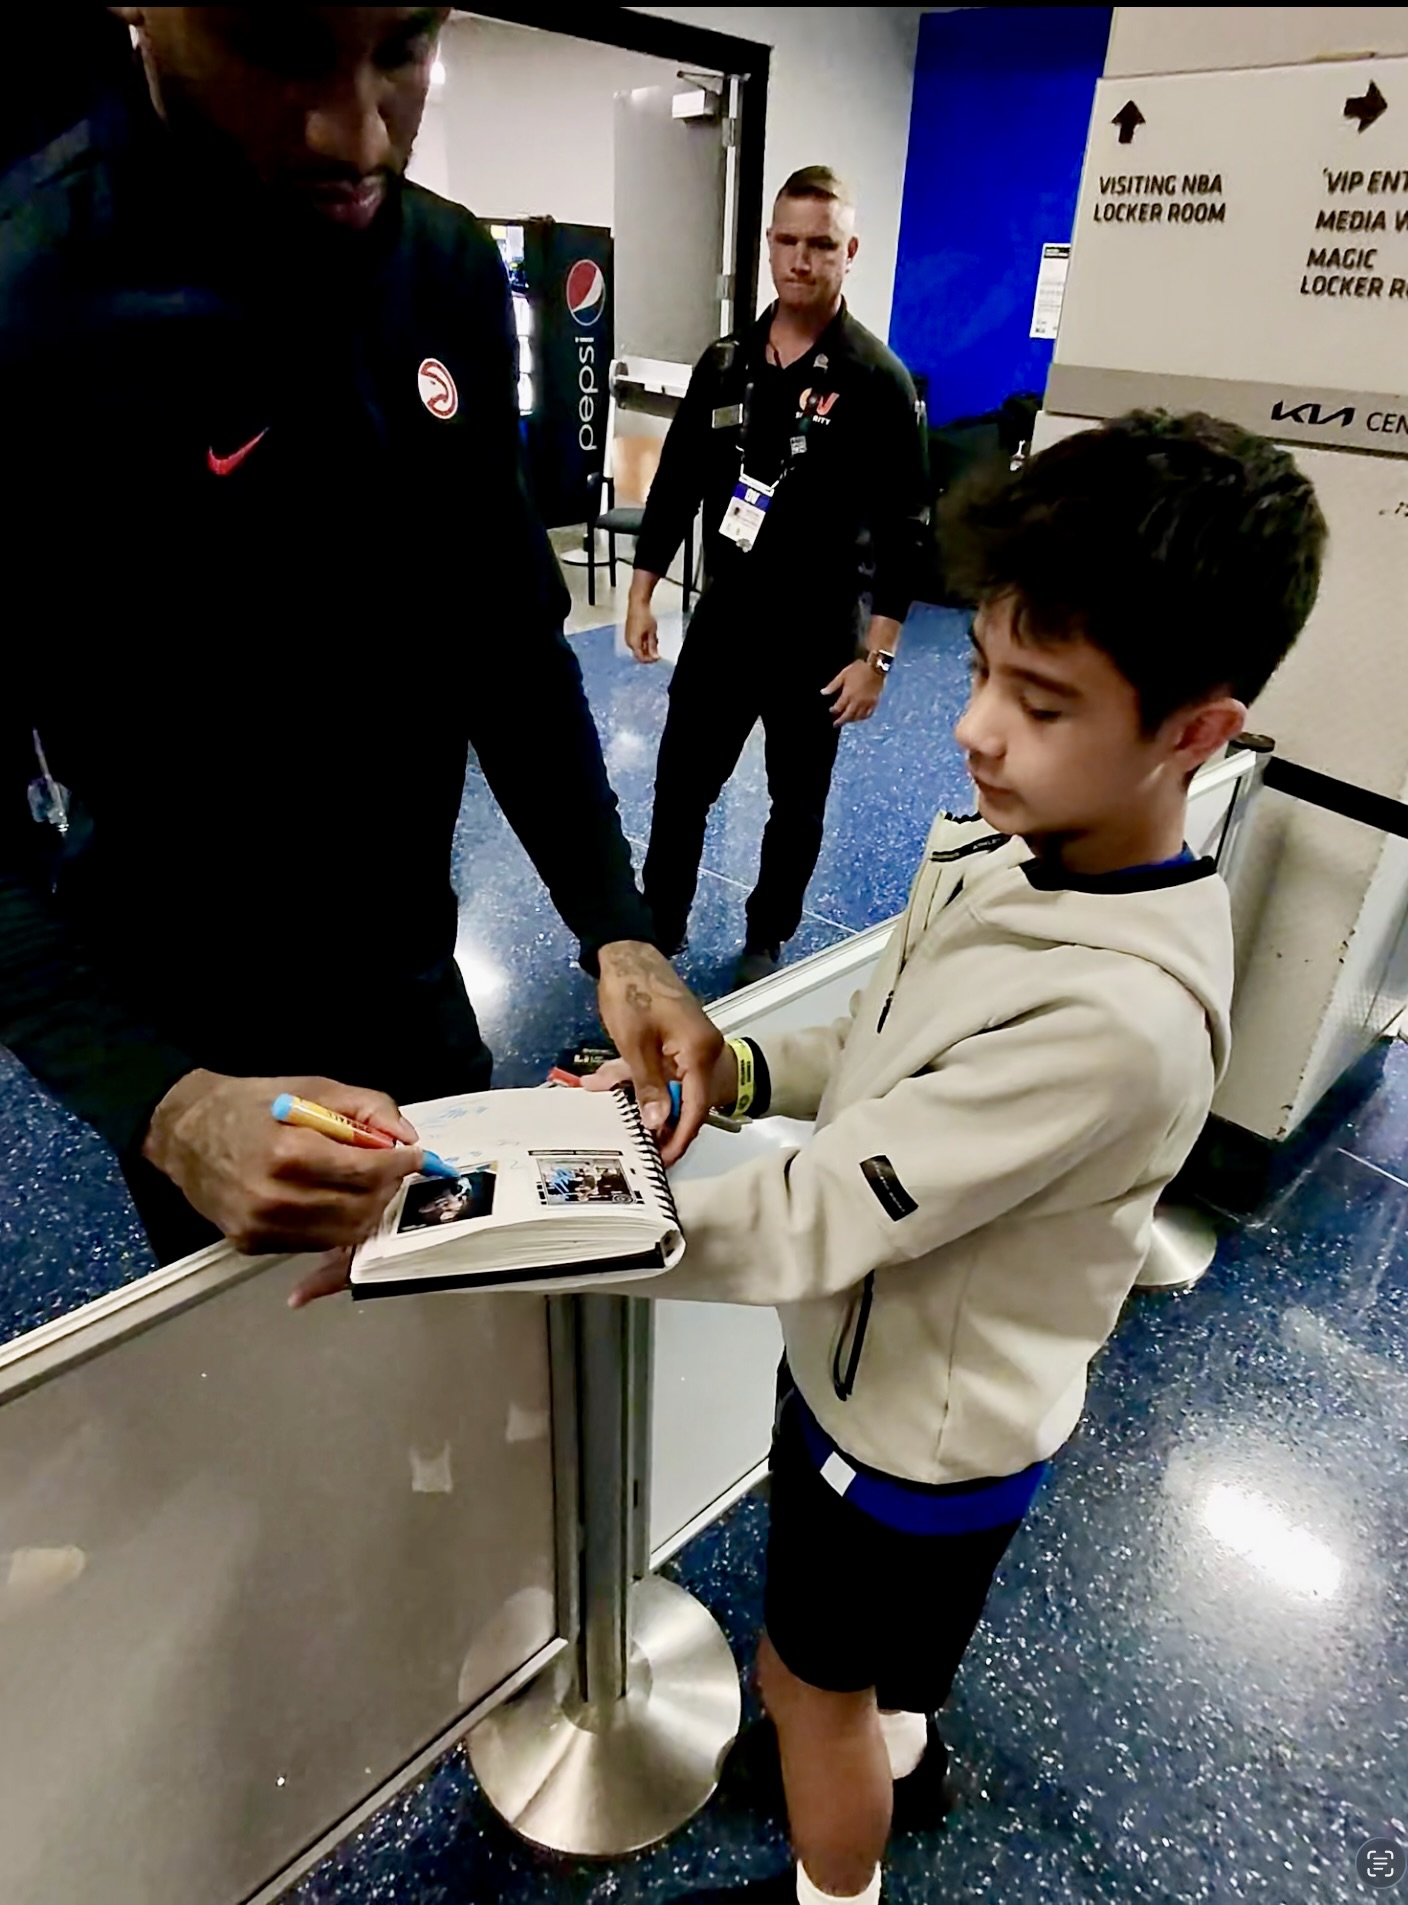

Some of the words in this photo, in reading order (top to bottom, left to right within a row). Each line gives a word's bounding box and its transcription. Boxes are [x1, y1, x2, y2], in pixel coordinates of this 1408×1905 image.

[1099, 174, 1177, 196] VISITING
[1181, 173, 1222, 196] NBA
[1093, 202, 1164, 223] LOCKER
[1167, 202, 1226, 224] ROOM
[1315, 209, 1386, 232] MEDIA
[1306, 247, 1378, 270] MAGIC
[1300, 274, 1384, 298] LOCKER
[575, 336, 599, 451] pepsi
